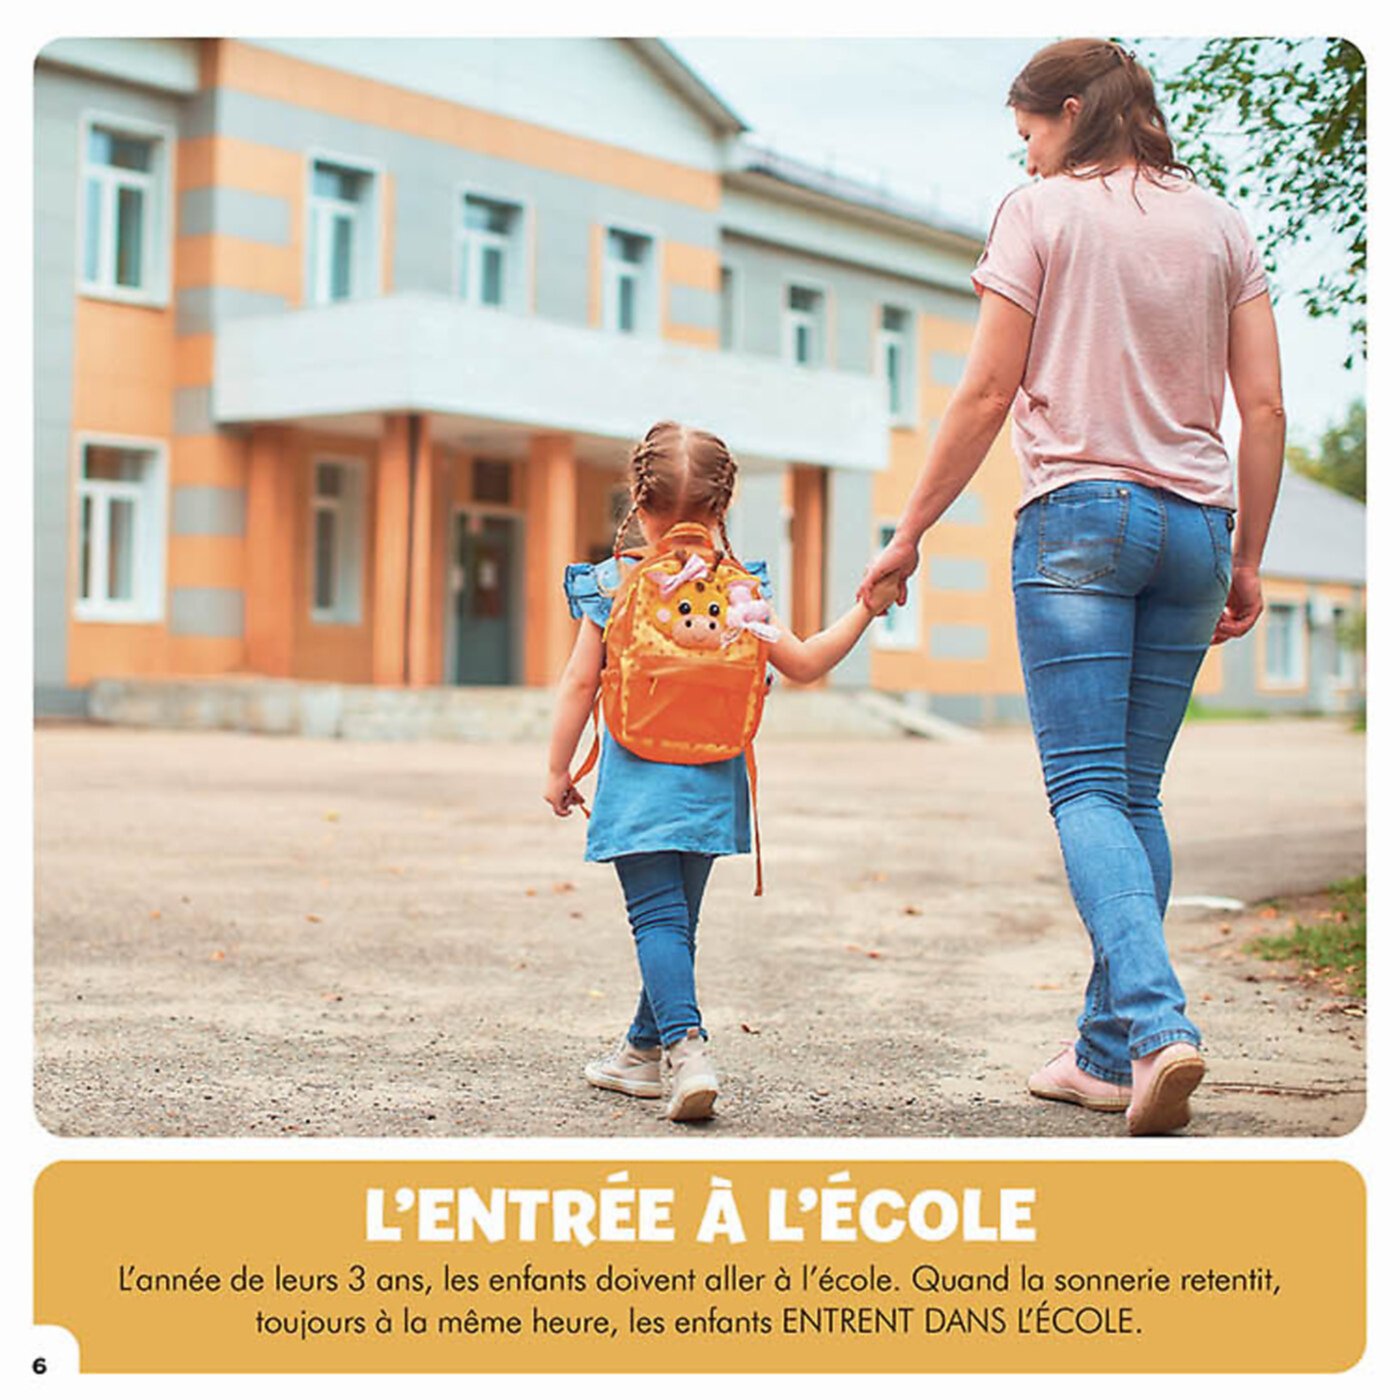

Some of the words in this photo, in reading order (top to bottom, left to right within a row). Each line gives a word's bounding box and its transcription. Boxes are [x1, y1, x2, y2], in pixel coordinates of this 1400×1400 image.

[367, 1171, 674, 1246] L’ENTRÉE
[697, 1176, 746, 1243] À
[769, 1171, 1036, 1242] L’ÉCOLE
[120, 1265, 221, 1292] L’année
[231, 1264, 264, 1292] de
[276, 1264, 338, 1292] leurs
[349, 1265, 365, 1291] 3
[377, 1274, 432, 1295] ans,
[445, 1264, 479, 1292] les
[489, 1264, 586, 1292] enfants
[596, 1264, 696, 1292] doivent
[705, 1264, 766, 1292] aller
[775, 1267, 790, 1292] à
[803, 1264, 899, 1292] l’école.
[912, 1264, 1008, 1293] Quand
[1022, 1264, 1047, 1292] la
[1055, 1268, 1170, 1292] sonnerie
[1182, 1268, 1280, 1295] retentit,
[256, 1310, 366, 1340] toujours
[376, 1309, 392, 1334] à
[404, 1307, 426, 1334] la
[439, 1309, 521, 1334] même
[533, 1307, 617, 1338] heure,
[630, 1307, 665, 1334] les
[675, 1306, 772, 1334] enfants
[784, 1307, 915, 1333] ENTRENT
[926, 1307, 1006, 1334] DANS
[1019, 1300, 1141, 1334] L’ÉCOLE.
[32, 1357, 48, 1375] 6
